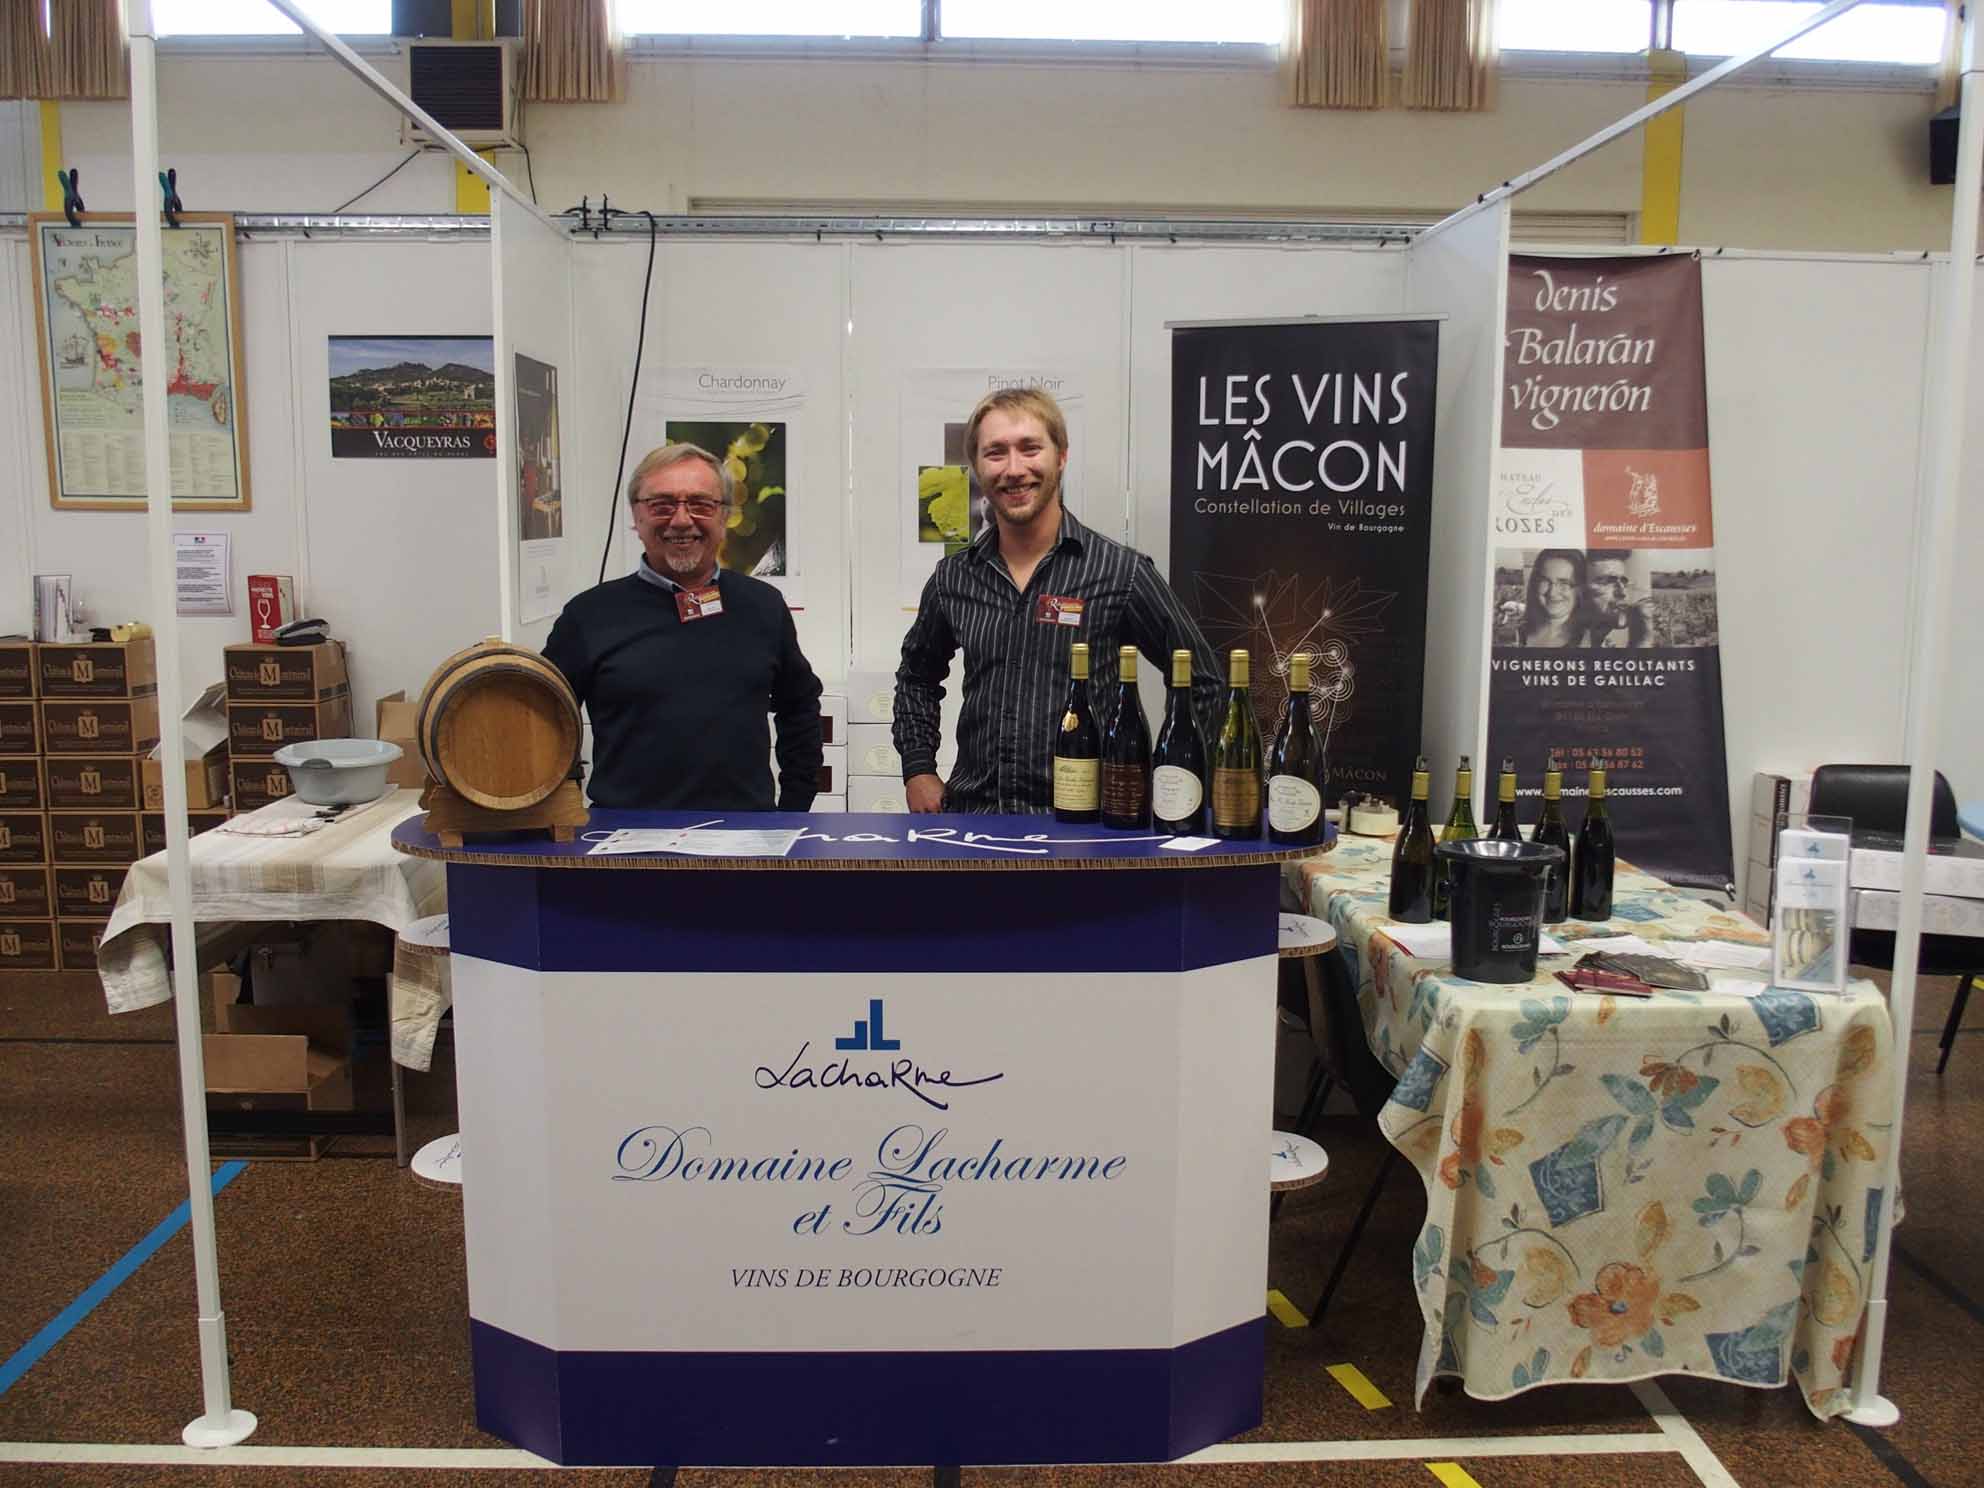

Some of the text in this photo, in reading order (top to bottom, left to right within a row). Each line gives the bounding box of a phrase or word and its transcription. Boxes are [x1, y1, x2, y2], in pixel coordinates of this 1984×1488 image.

[1533, 269, 1618, 312] denis
[698, 374, 785, 393] Chardonnay
[988, 375, 1064, 391] Pinot Noir
[1200, 371, 1409, 425] LES VINS
[1197, 427, 1407, 493] MÂCON
[1194, 497, 1406, 520] Constellation de Villages
[1327, 522, 1405, 533] Vin de Bourgogne
[1492, 659, 1696, 672] VIGNERONS RECOLTANTS
[1522, 674, 1666, 687] VINS DE GAILLAC
[611, 1124, 1127, 1188] Domaine Lacharme
[792, 1183, 943, 1236] et Fils
[730, 1268, 1003, 1288] VINS DE BOURGOGNE
